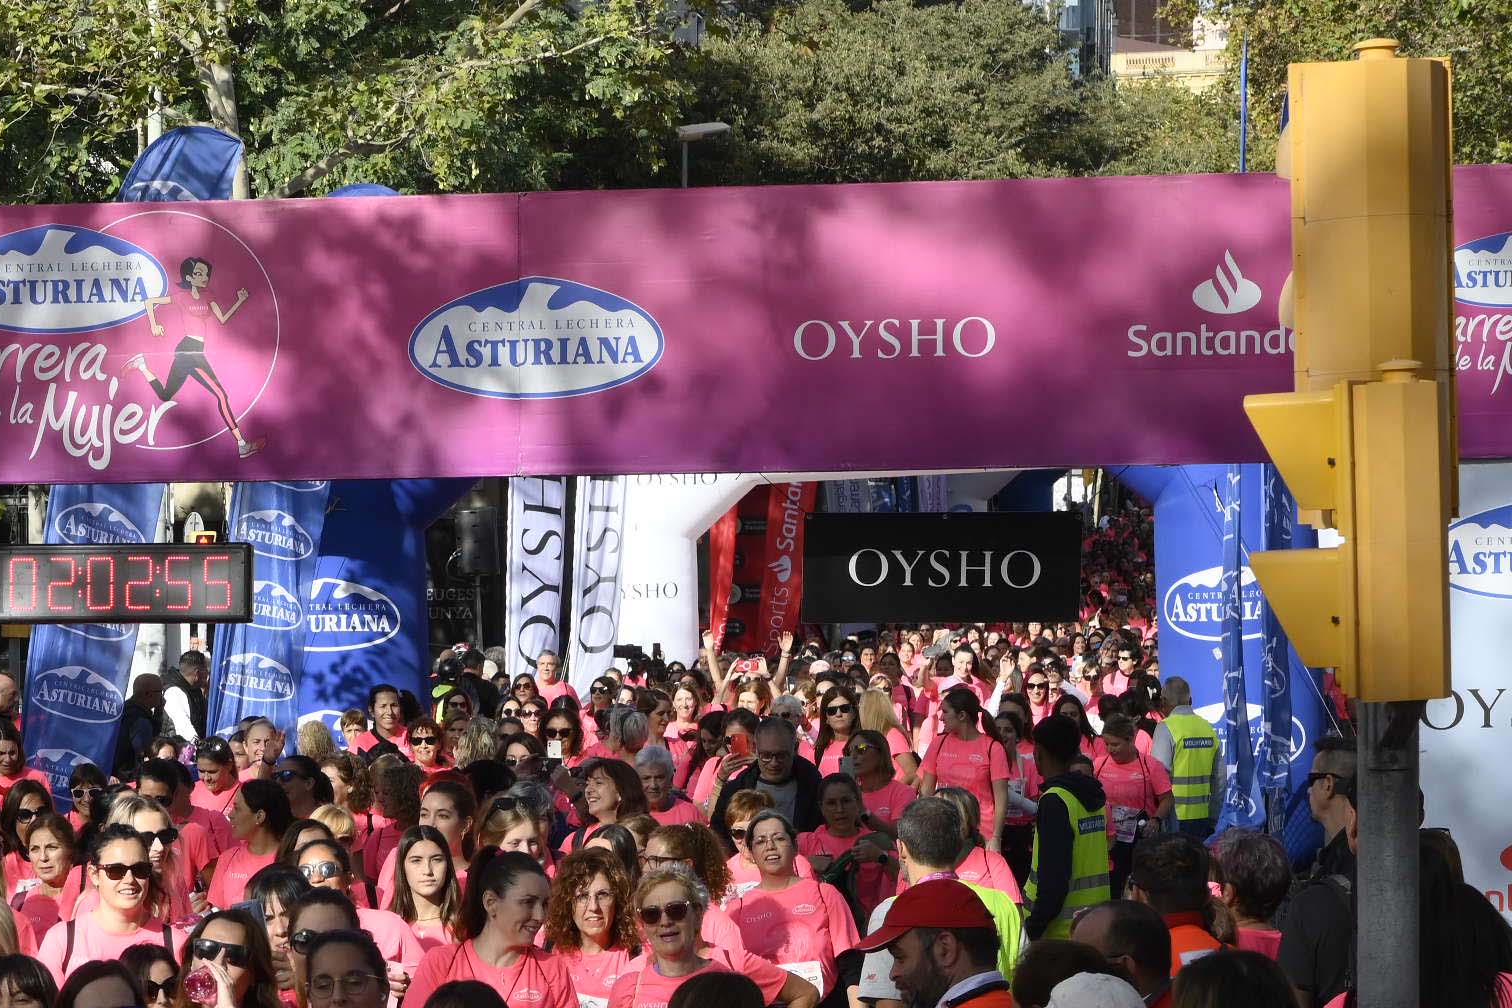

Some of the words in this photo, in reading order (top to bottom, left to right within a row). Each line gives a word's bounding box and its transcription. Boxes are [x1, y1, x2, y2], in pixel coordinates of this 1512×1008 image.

[71, 261, 142, 272] LECHERA
[1454, 257, 1512, 288] ASTU
[469, 321, 541, 332] CENTRAL
[548, 317, 636, 330] LECHERA
[794, 316, 996, 361] OYSHO
[428, 325, 643, 369] ASTURIANA
[1478, 344, 1494, 371] la
[9, 385, 34, 425] la
[29, 377, 177, 470] Mujer
[848, 548, 1041, 590] OYSHO
[1448, 539, 1512, 576] AST
[9, 556, 232, 611] 02:02:55
[38, 680, 118, 716] ASTURIANA
